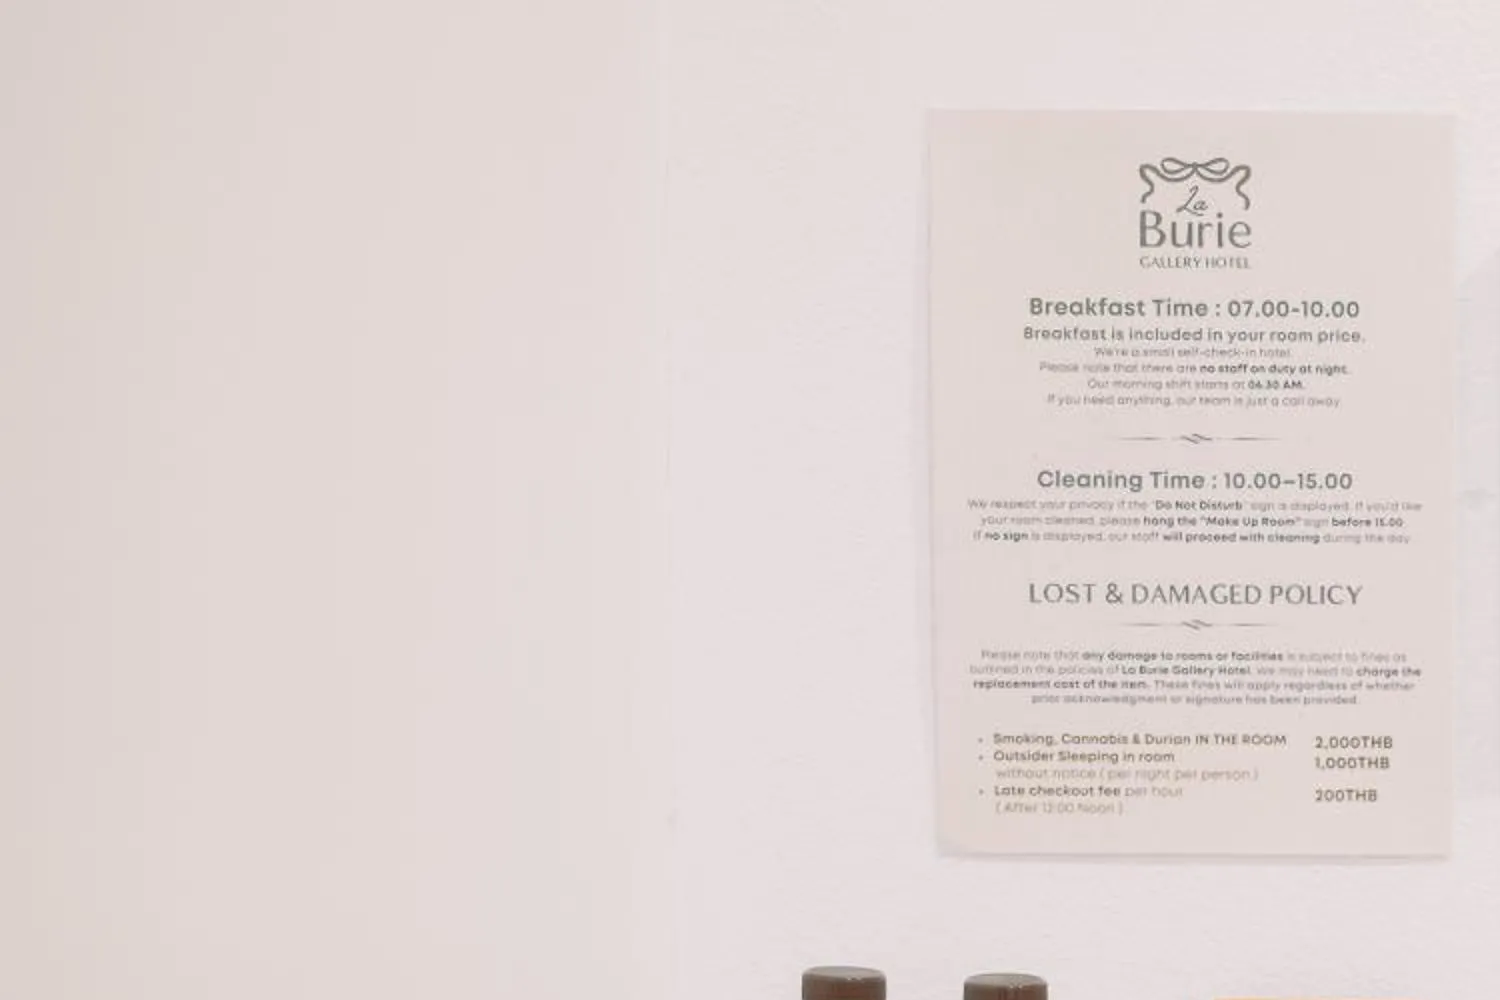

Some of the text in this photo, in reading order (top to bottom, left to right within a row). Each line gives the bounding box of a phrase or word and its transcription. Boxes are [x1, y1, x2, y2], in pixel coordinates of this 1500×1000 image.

[1176, 185, 1208, 216] La
[1139, 210, 1252, 249] Burie
[1139, 256, 1250, 269] GALLERY HOTEL
[1030, 298, 1145, 317] Breakfast
[1152, 297, 1208, 317] Time
[1228, 300, 1360, 318] 07.00-10.00
[1024, 327, 1366, 345] Breakfast is included in your room price.
[1199, 364, 1216, 374] no
[1218, 363, 1247, 374] staff
[1250, 365, 1266, 374] on
[1268, 363, 1296, 376] duty
[1299, 364, 1312, 375] at
[1038, 470, 1143, 492] Cleaning
[1150, 470, 1205, 489] Time
[1174, 500, 1197, 510] Not
[1144, 516, 1174, 527] hang
[1177, 516, 1197, 526] the
[1242, 516, 1258, 527] Up
[1332, 517, 1371, 527] before
[984, 531, 1320, 544] no sign will proceed with cleaning
[1029, 583, 1364, 606] LOST & DAMAGED POLICY
[1082, 650, 1105, 661] any
[1107, 650, 1158, 662] damage
[1160, 650, 1173, 661] to
[1175, 650, 1213, 661] rooms
[1216, 651, 1229, 662] or
[1121, 665, 1137, 676] La
[1172, 665, 1215, 676] Gallery
[1356, 666, 1399, 678] charge
[1401, 666, 1421, 677] the
[973, 679, 1051, 691] replacement
[1054, 679, 1080, 690] cost
[1083, 680, 1095, 690] of
[1098, 680, 1118, 690] the
[1061, 733, 1128, 745] Cannabis
[1144, 734, 1190, 745] Durian
[1195, 734, 1209, 745] IN
[1215, 734, 1237, 745] THE
[1242, 734, 1286, 745] ROOM
[994, 750, 1175, 764] Outsider Sleeping in room
[1201, 766, 1251, 782] person
[995, 784, 1183, 797] Late checkout fee per hour
[1316, 789, 1377, 802] 200THB
